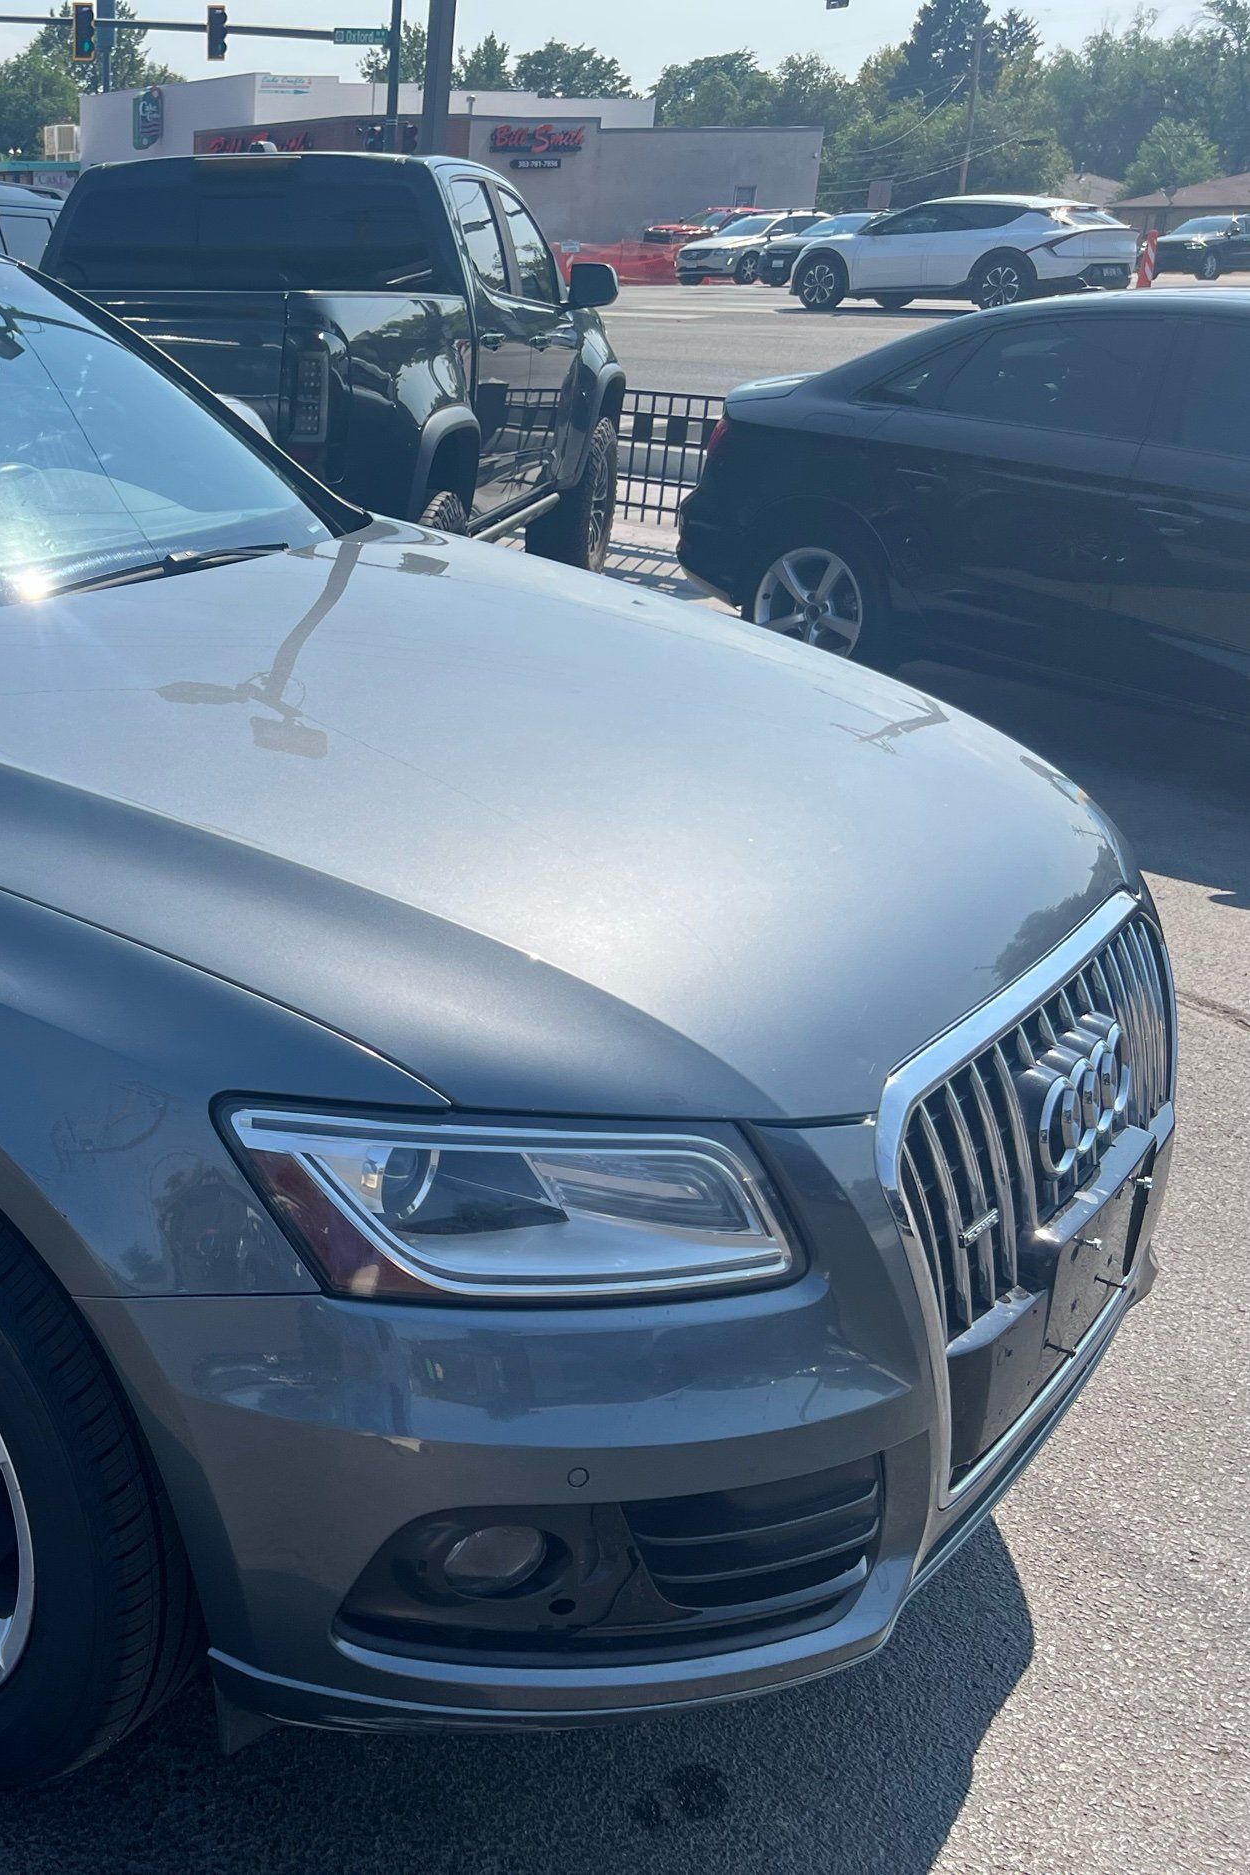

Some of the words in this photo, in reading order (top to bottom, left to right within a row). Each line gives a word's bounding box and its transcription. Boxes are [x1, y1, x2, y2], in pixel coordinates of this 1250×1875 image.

[345, 30, 374, 43] Oxford
[494, 123, 528, 146] Bill
[531, 124, 586, 153] Smith
